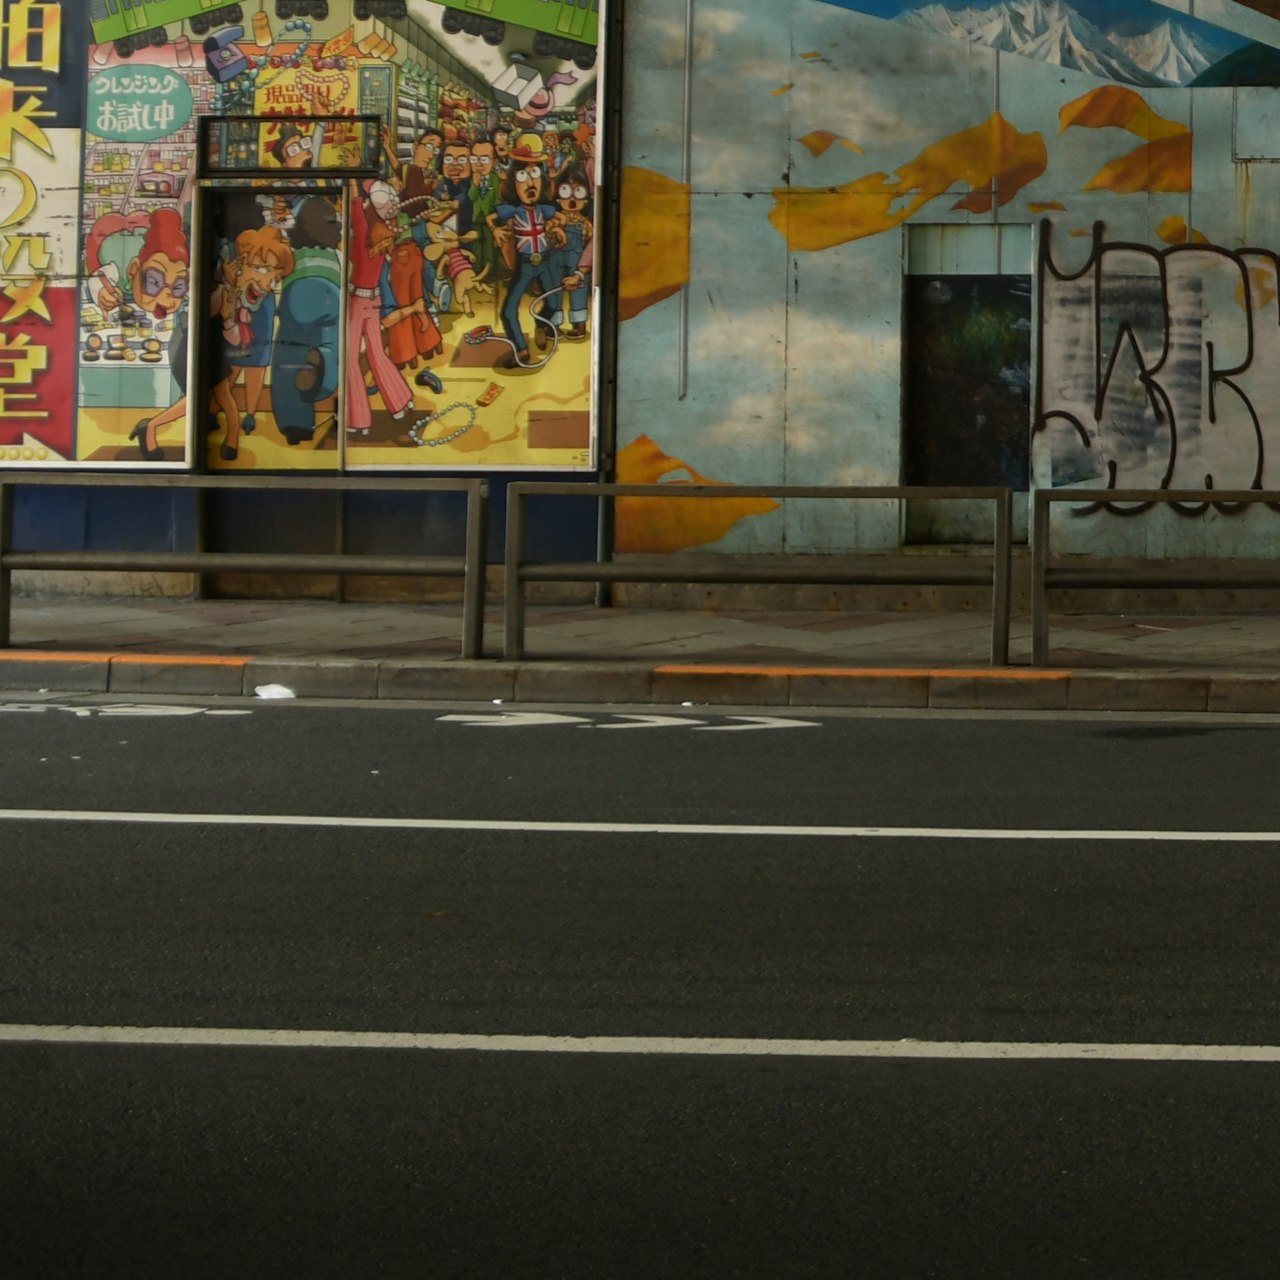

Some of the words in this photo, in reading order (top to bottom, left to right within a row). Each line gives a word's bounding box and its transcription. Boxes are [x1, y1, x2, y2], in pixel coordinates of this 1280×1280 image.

[95, 74, 180, 95] クレンジング
[97, 99, 177, 133] お試し中
